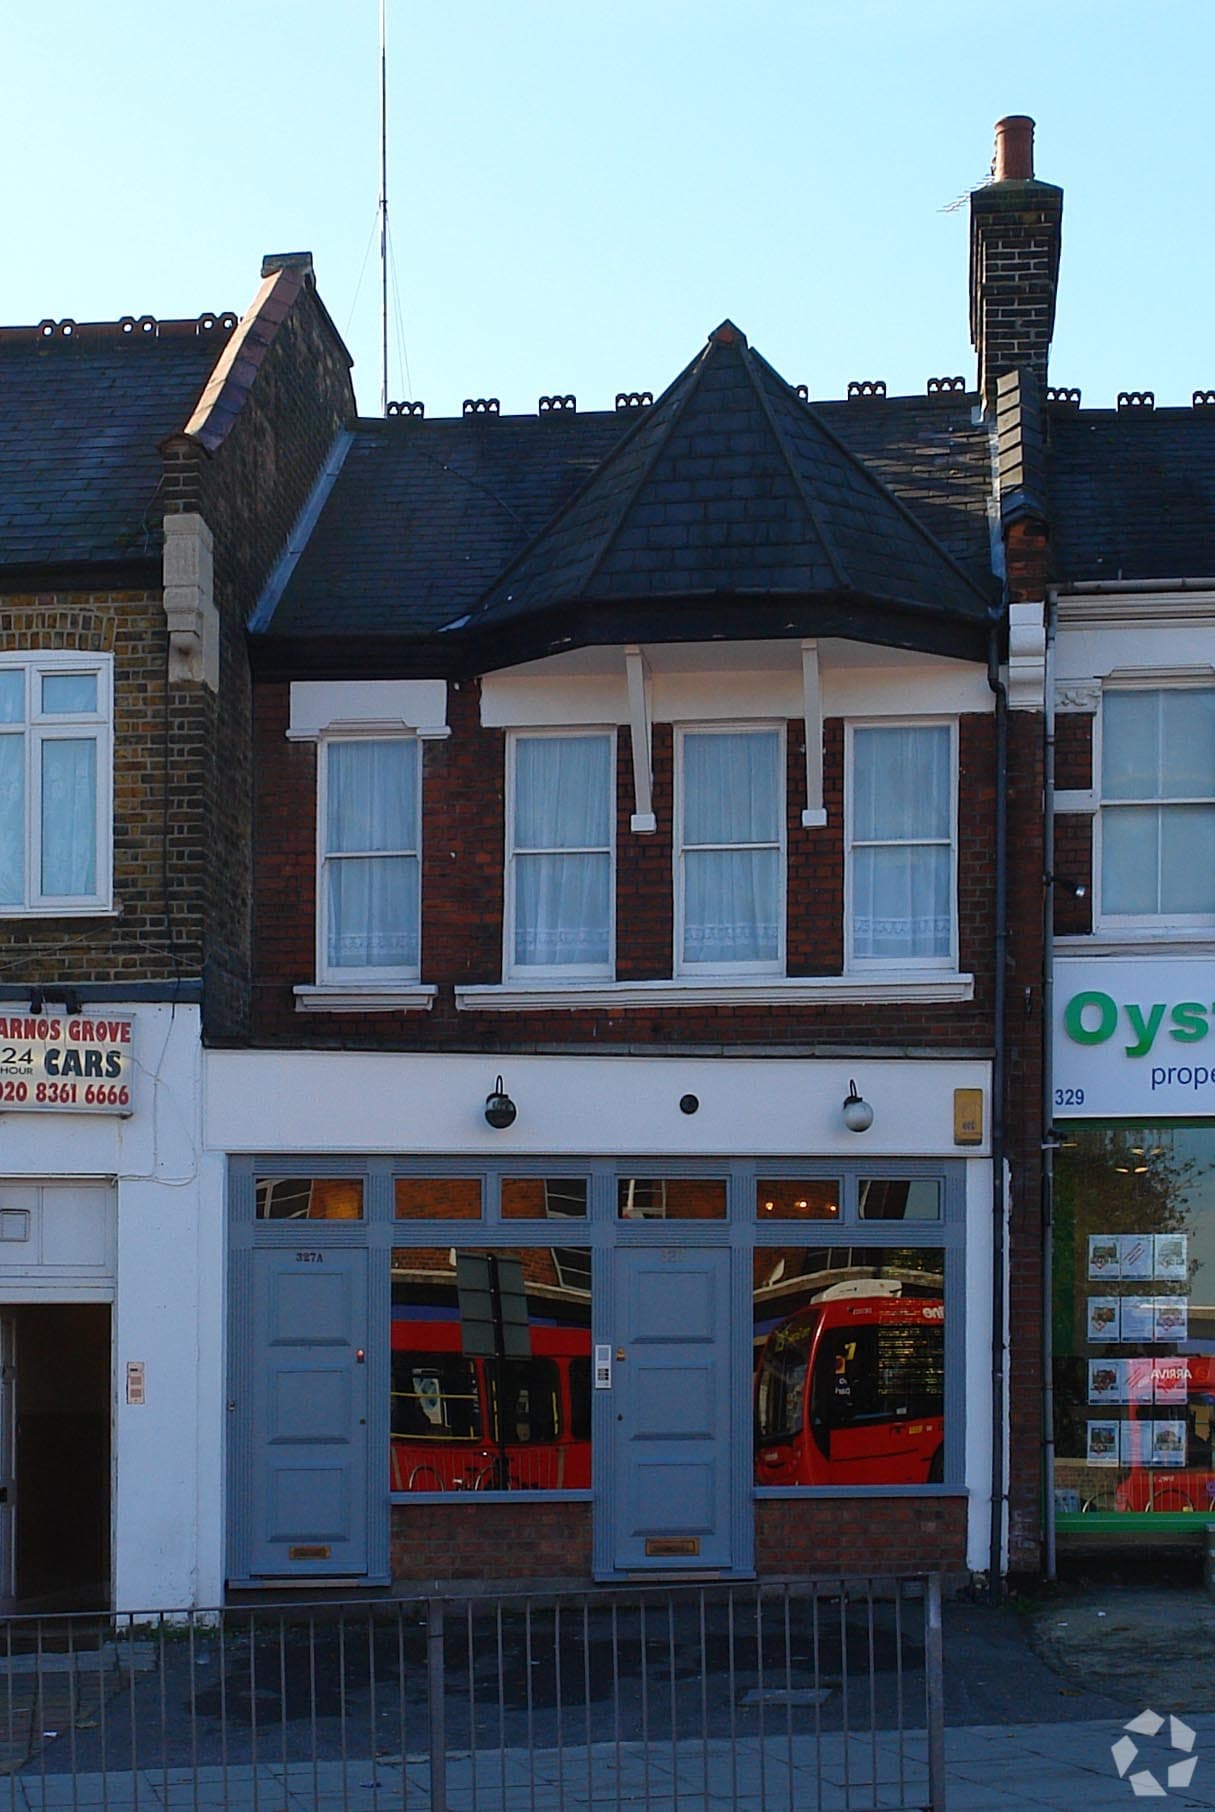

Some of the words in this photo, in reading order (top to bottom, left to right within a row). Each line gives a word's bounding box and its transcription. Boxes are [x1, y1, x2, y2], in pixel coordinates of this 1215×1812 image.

[69, 1020, 131, 1043] GROVE
[1065, 991, 1215, 1058] Oys
[2, 1047, 33, 1065] 24
[44, 1048, 121, 1078] CARS
[0, 1066, 33, 1075] HOUR
[36, 1082, 77, 1104] 8361
[85, 1084, 129, 1105] 6666
[1055, 1089, 1084, 1105] 329
[296, 1252, 323, 1263] 327A
